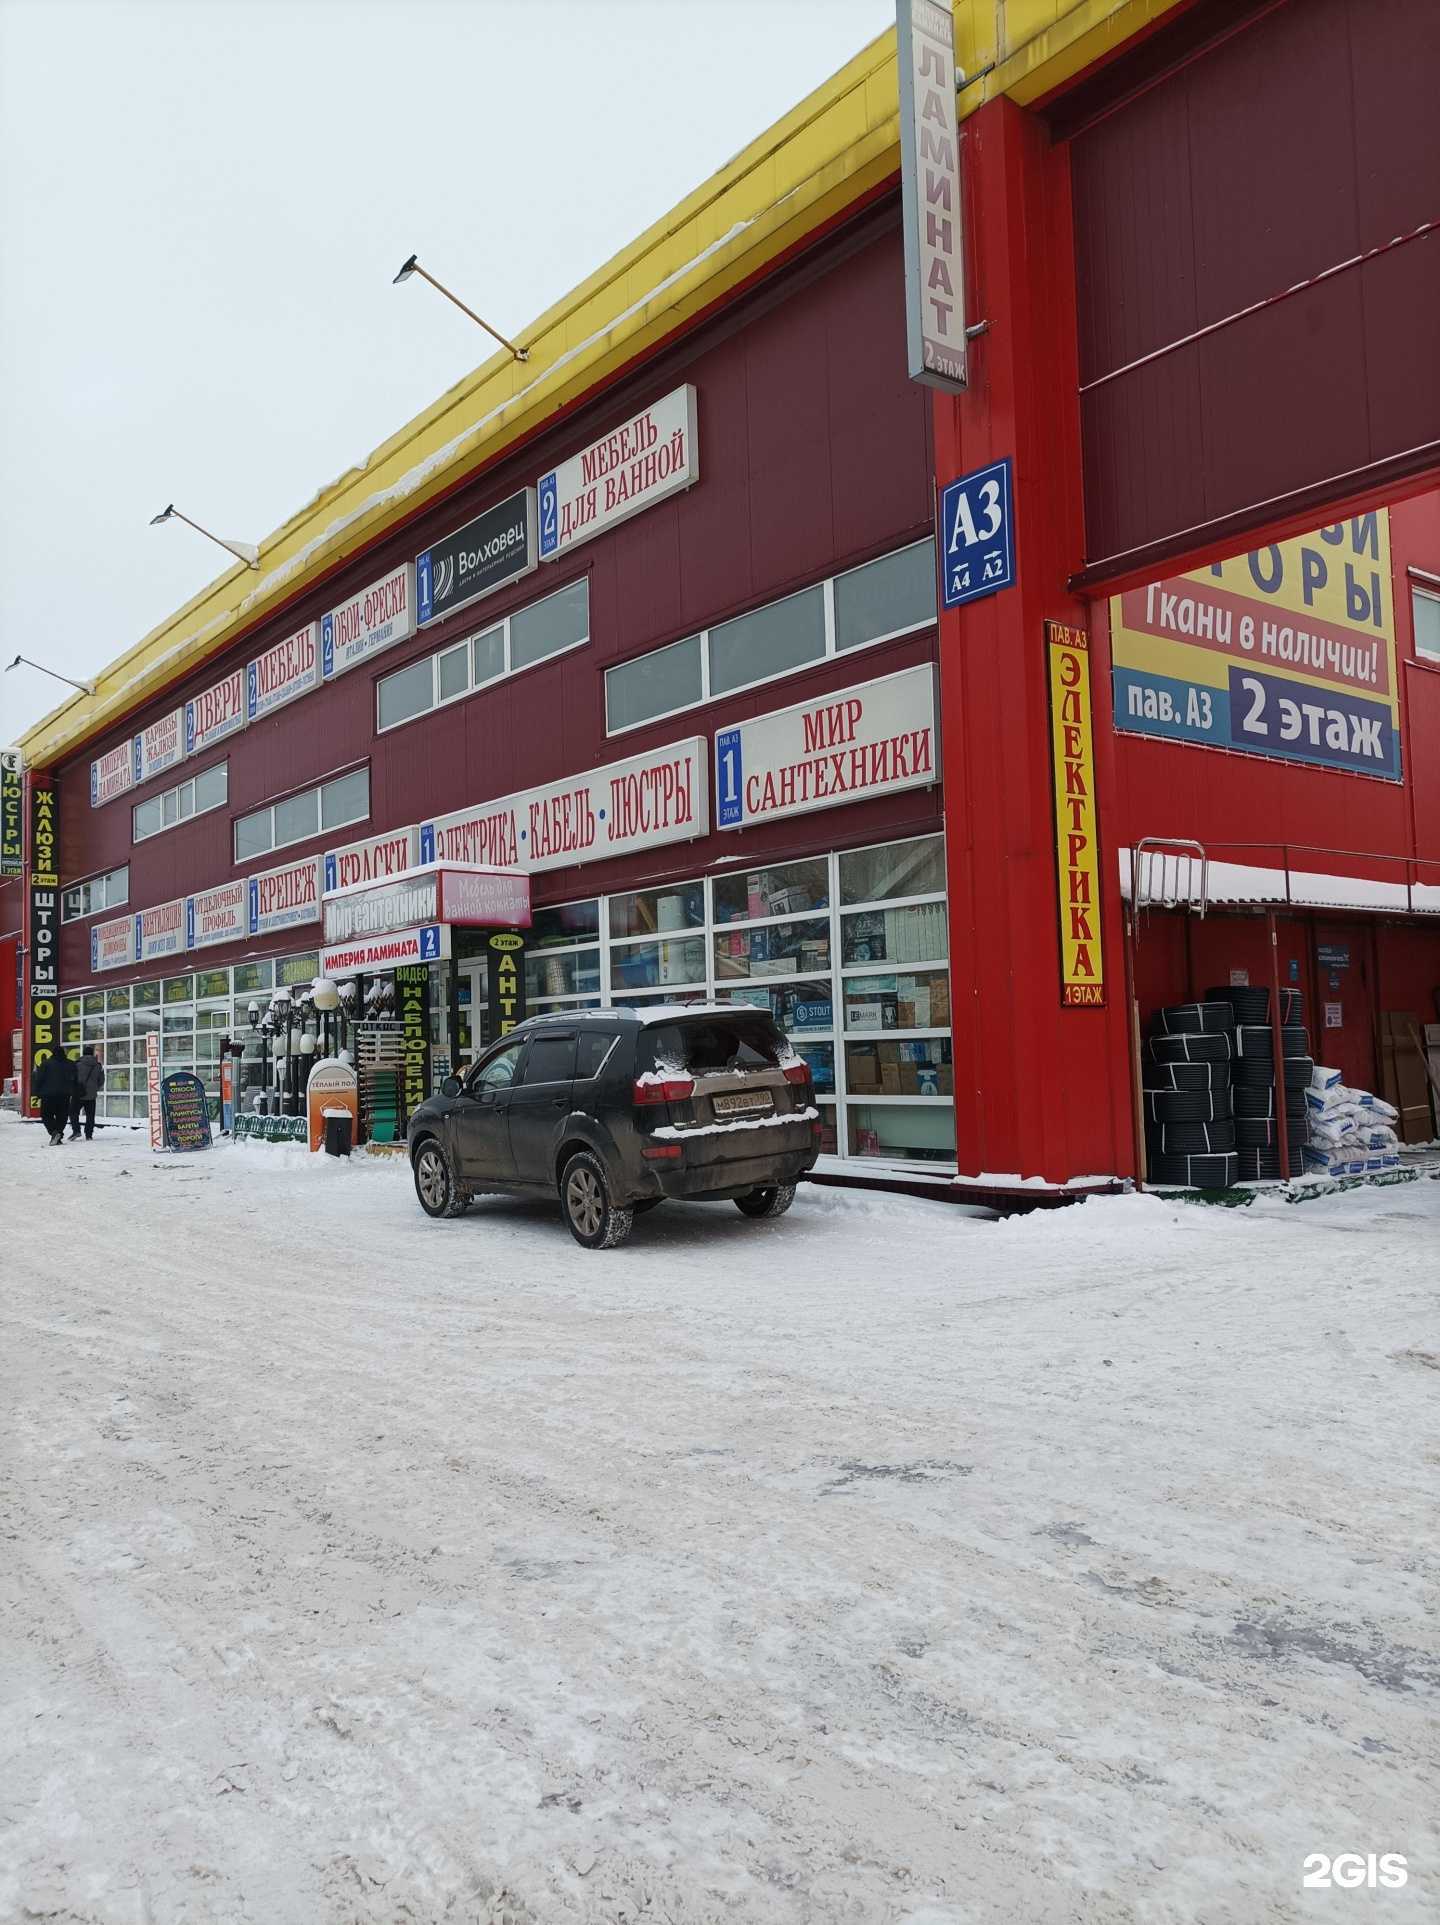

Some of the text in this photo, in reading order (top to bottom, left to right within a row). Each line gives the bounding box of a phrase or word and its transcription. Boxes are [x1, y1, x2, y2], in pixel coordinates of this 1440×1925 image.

[919, 45, 954, 336] ЛАМИНАТ
[925, 340, 935, 369] 2
[581, 412, 658, 488] МЕБЕЛЬ
[560, 428, 686, 546] ДЛЯ ВАННОЙ
[543, 490, 556, 536] 2
[948, 479, 1002, 554] А3
[459, 520, 525, 576] Волховец
[421, 567, 430, 607] 1
[952, 559, 1003, 593] А4 А2
[335, 572, 406, 649] ОБОИ ФРЕСКИ
[1147, 582, 1378, 684] Ткани в наличии!
[257, 628, 315, 697] МЕБЕЛЬ
[324, 626, 332, 661] 2
[193, 673, 242, 746] ДВЕРИ
[249, 674, 256, 704] 2
[1128, 685, 1214, 730] пав. А3
[145, 712, 177, 747] КАРНИЗЫ
[187, 713, 193, 740] 2
[802, 699, 863, 754] МИР
[1242, 677, 1385, 759] 2 этаж
[723, 750, 738, 803] 1
[746, 727, 932, 814] САНТЕХНИКИ
[4, 772, 22, 856] ЛЮСТРЫ
[36, 791, 54, 871] ЖАЛЮЗИ
[437, 757, 693, 867] ЭЛЕКТРИКА КАБЕЛЬ ЛЮСТРЫ
[1061, 651, 1095, 978] ЭЛЕКТРИКА
[339, 838, 408, 887] КРАСКИ
[424, 841, 432, 863] 1
[33, 875, 40, 884] 2
[259, 863, 317, 915] КРЕПЕЖ
[327, 867, 335, 892] 1
[203, 909, 236, 933] ПРОФИЛЬ
[250, 889, 257, 921] 1
[35, 893, 55, 980] ШТОРЫ
[325, 948, 365, 971] ИМПЕРИЯ
[367, 939, 420, 964] ЛАМИНАТА
[426, 930, 435, 951] 2
[32, 987, 39, 996] 2
[396, 966, 429, 985] ВИДЕО
[1072, 985, 1103, 1004] ЭТАЖ
[808, 1006, 831, 1017] STOUT
